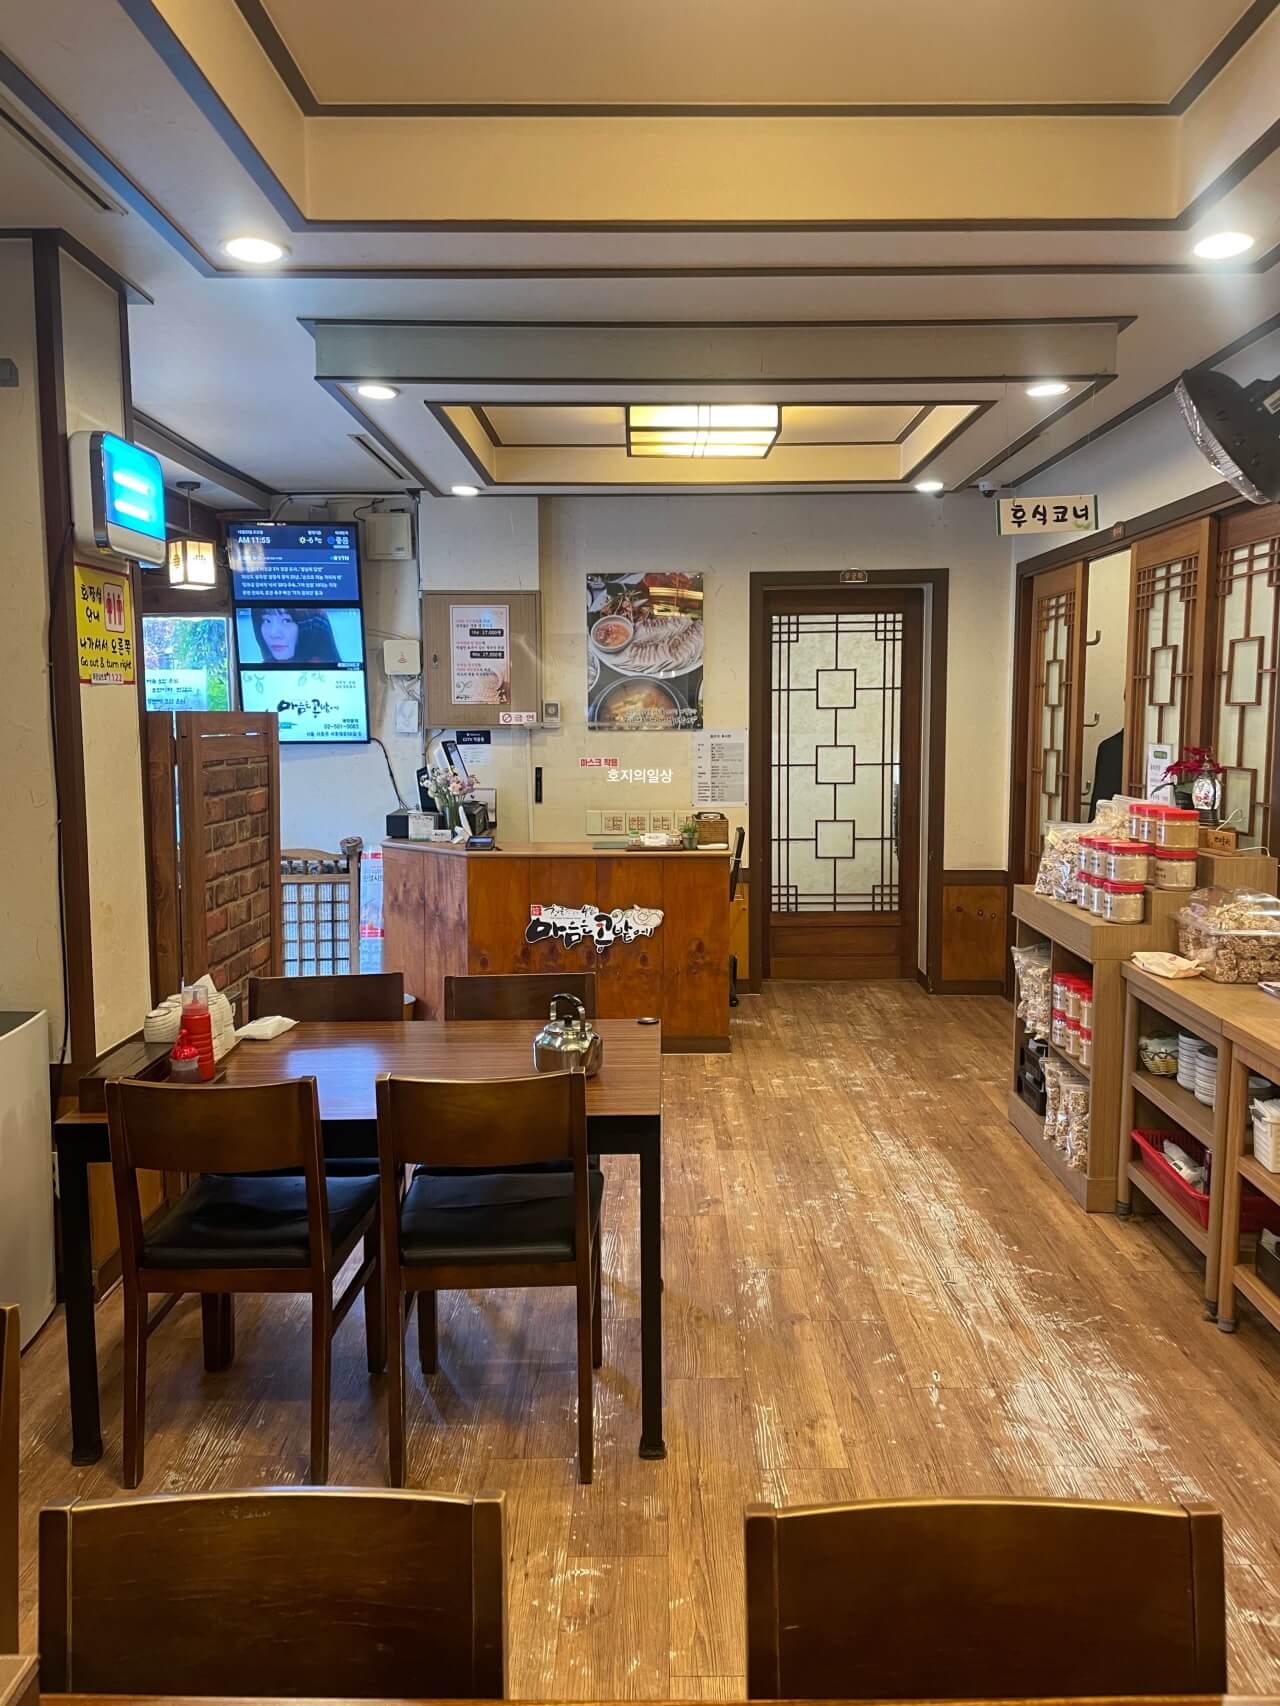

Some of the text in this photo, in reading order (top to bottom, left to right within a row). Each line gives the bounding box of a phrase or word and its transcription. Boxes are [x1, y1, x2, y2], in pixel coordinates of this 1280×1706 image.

[1011, 504, 1089, 528] 후식코너
[80, 584, 102, 605] 화장실
[86, 606, 100, 622] 안내
[80, 638, 131, 656] 나가셔서 오른쪽
[80, 656, 89, 667] Go
[89, 659, 99, 668] out
[106, 658, 119, 669] turn
[120, 659, 132, 672] right
[515, 714, 534, 722] 금연
[580, 758, 601, 766] 마스크
